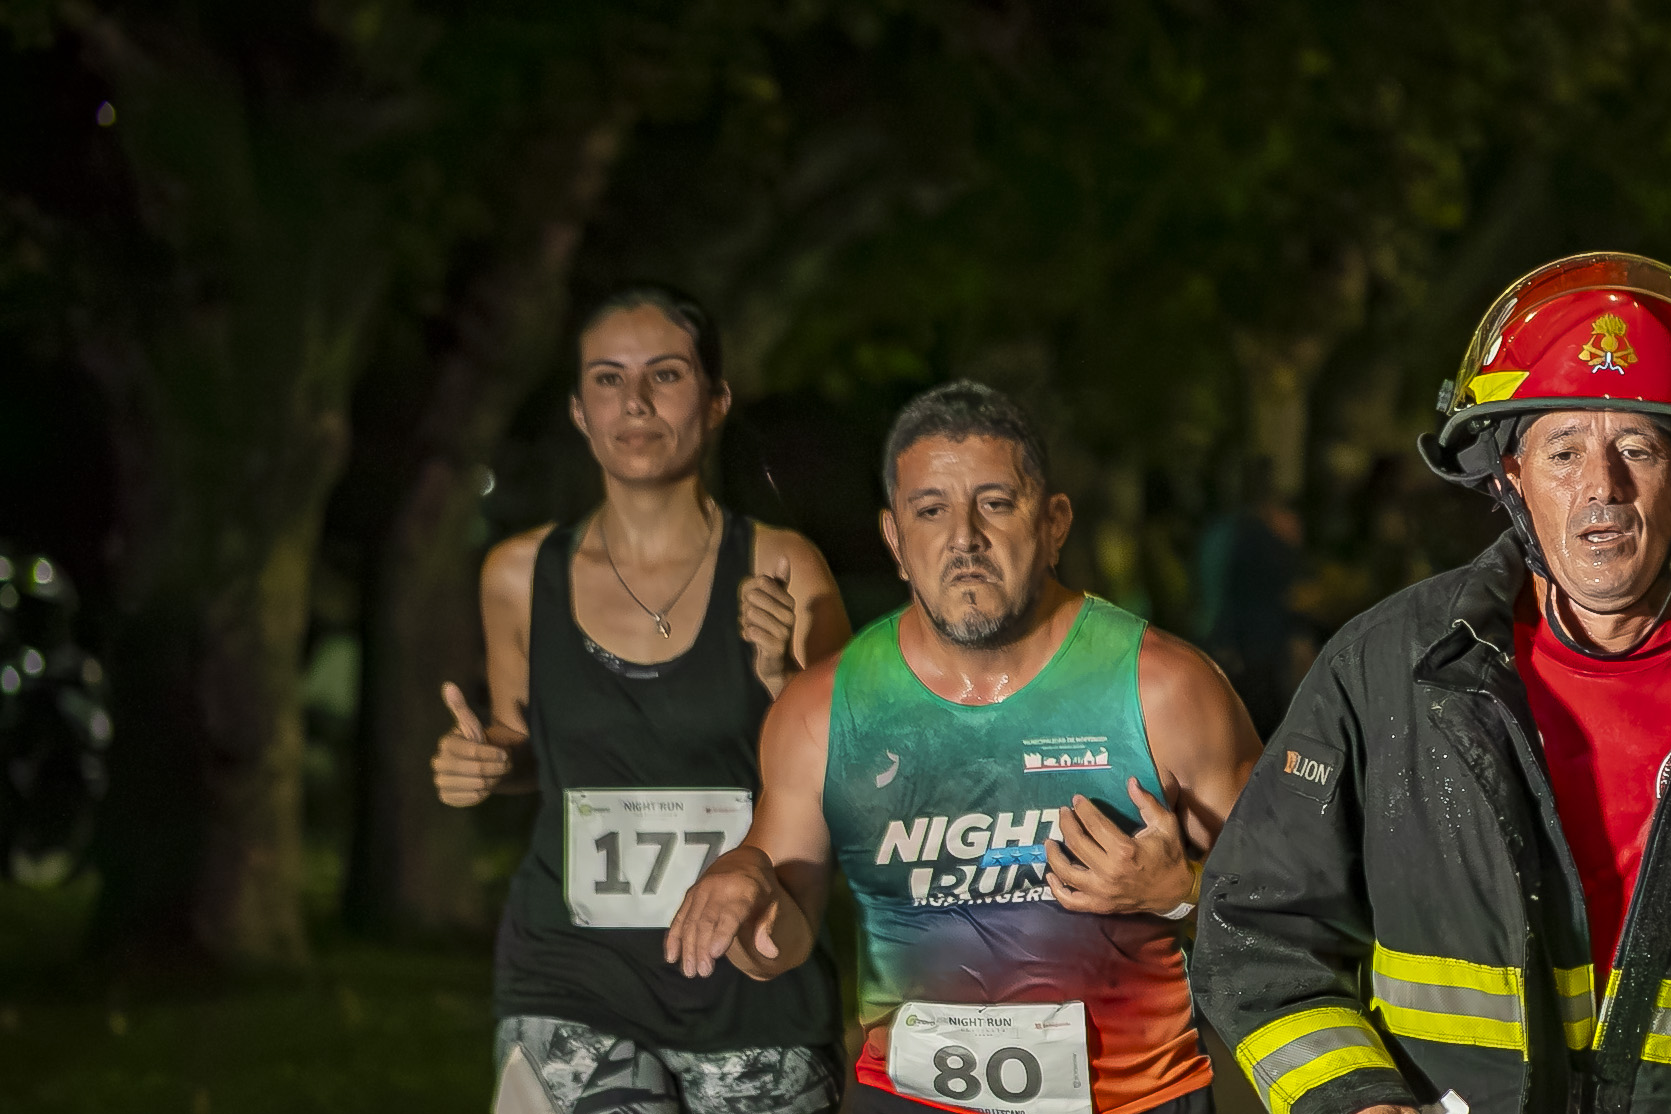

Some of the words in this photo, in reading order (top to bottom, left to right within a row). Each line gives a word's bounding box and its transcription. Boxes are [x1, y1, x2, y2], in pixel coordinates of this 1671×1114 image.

[1293, 755, 1331, 785] LION
[624, 800, 656, 812] NIGHT
[660, 800, 684, 812] RUN
[875, 808, 1064, 865] NIGHT
[594, 831, 726, 894] 177
[949, 1016, 984, 1027] NIGHT
[987, 1017, 1012, 1027] RUN
[933, 1044, 1043, 1104] 80
